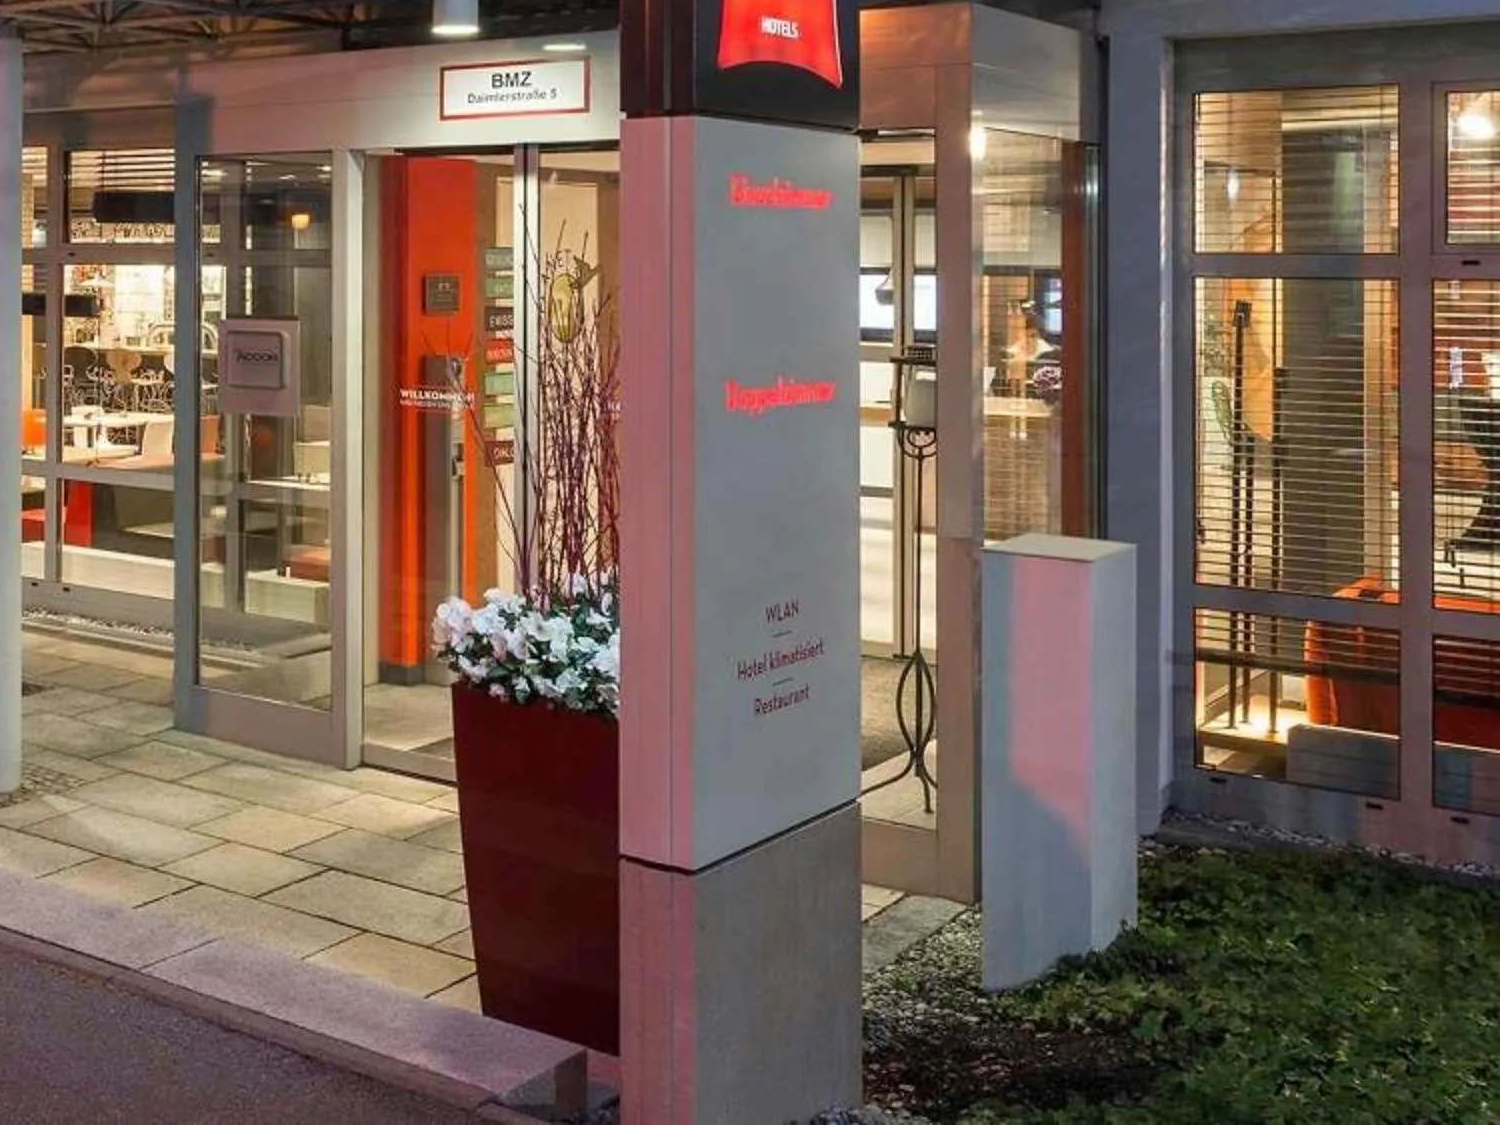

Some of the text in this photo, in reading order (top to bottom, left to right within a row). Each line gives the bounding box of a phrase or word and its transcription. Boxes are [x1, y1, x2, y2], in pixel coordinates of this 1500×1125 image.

[760, 16, 799, 38] HOTELS
[491, 71, 532, 88] BMZ
[765, 599, 799, 623] WLAN
[737, 652, 767, 681] Hotel
[753, 683, 809, 715] Restaurant
